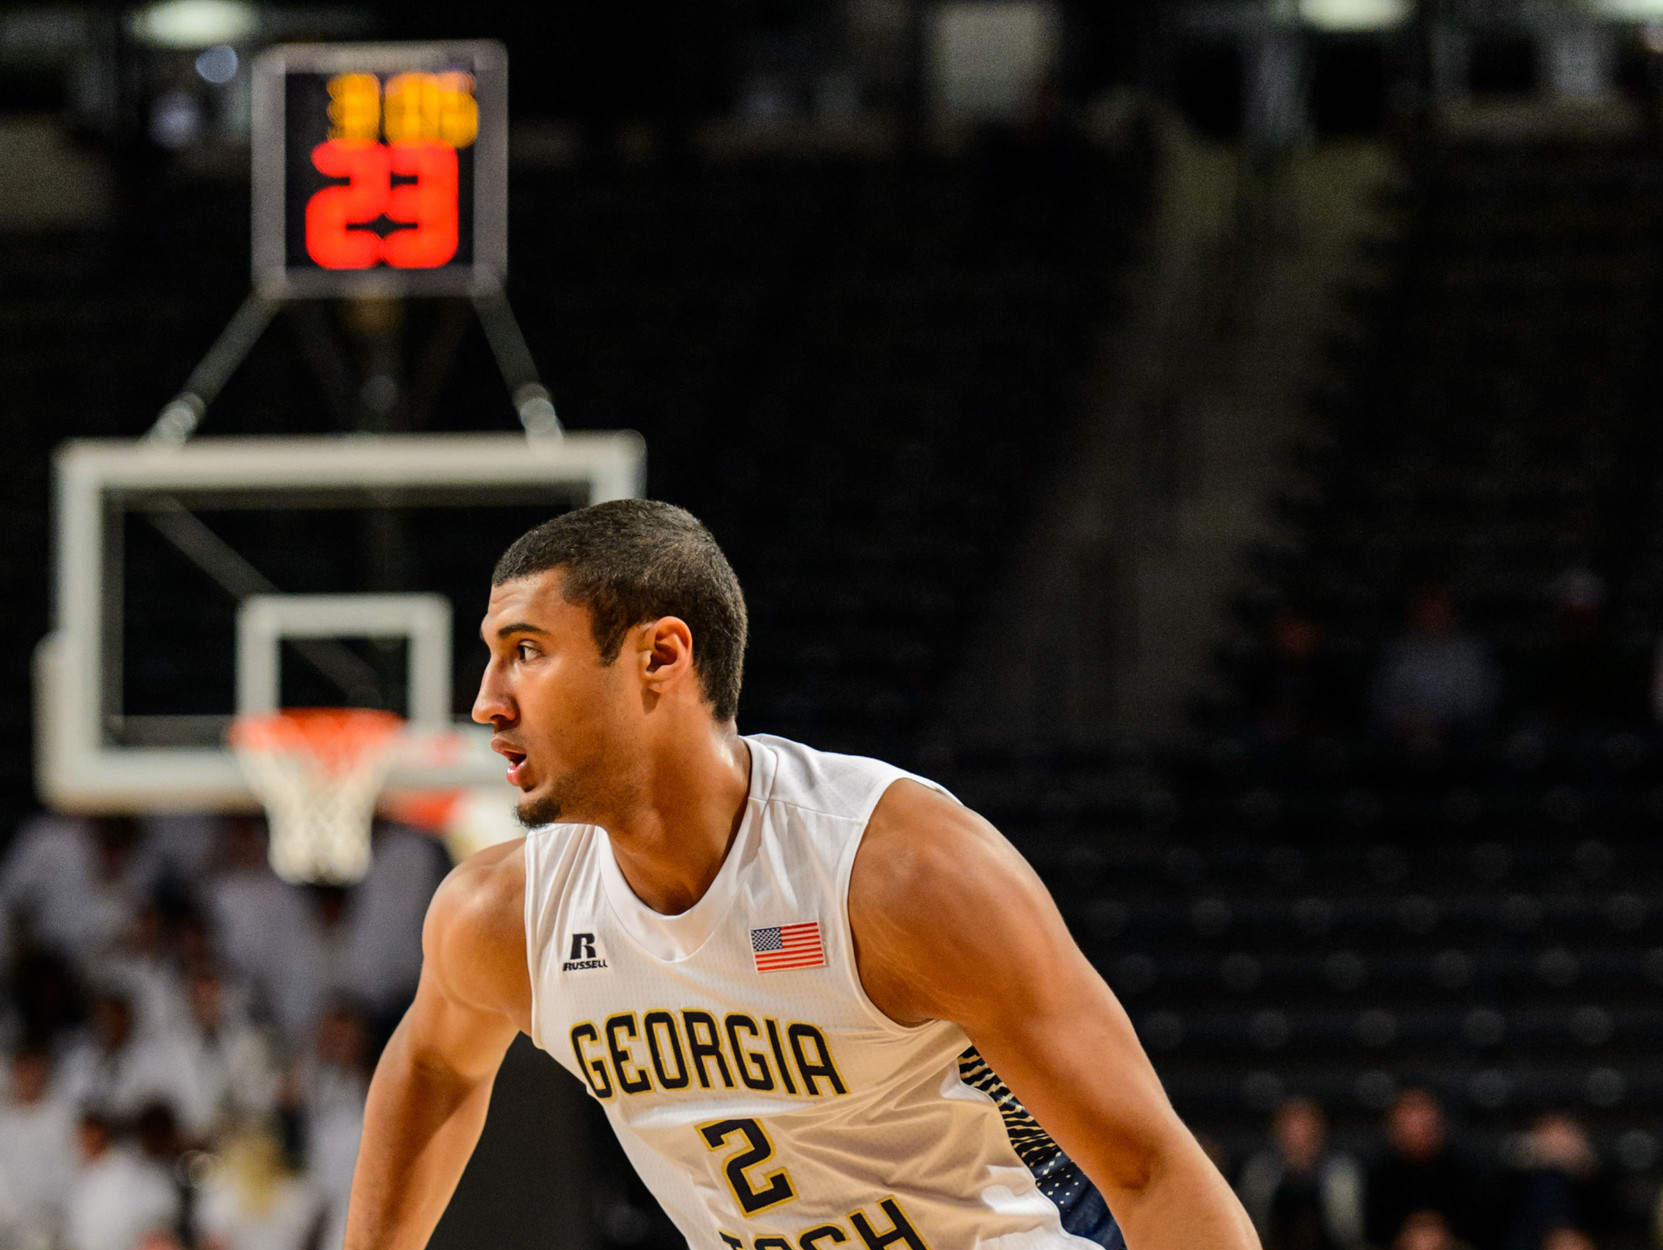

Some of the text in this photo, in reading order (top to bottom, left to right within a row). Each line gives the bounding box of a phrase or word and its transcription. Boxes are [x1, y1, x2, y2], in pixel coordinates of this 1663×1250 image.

[305, 137, 459, 270] 23
[562, 959, 609, 972] RUSSELL
[570, 932, 597, 960] R
[570, 1008, 851, 1101] GEORGIA
[695, 1117, 799, 1218] 2
